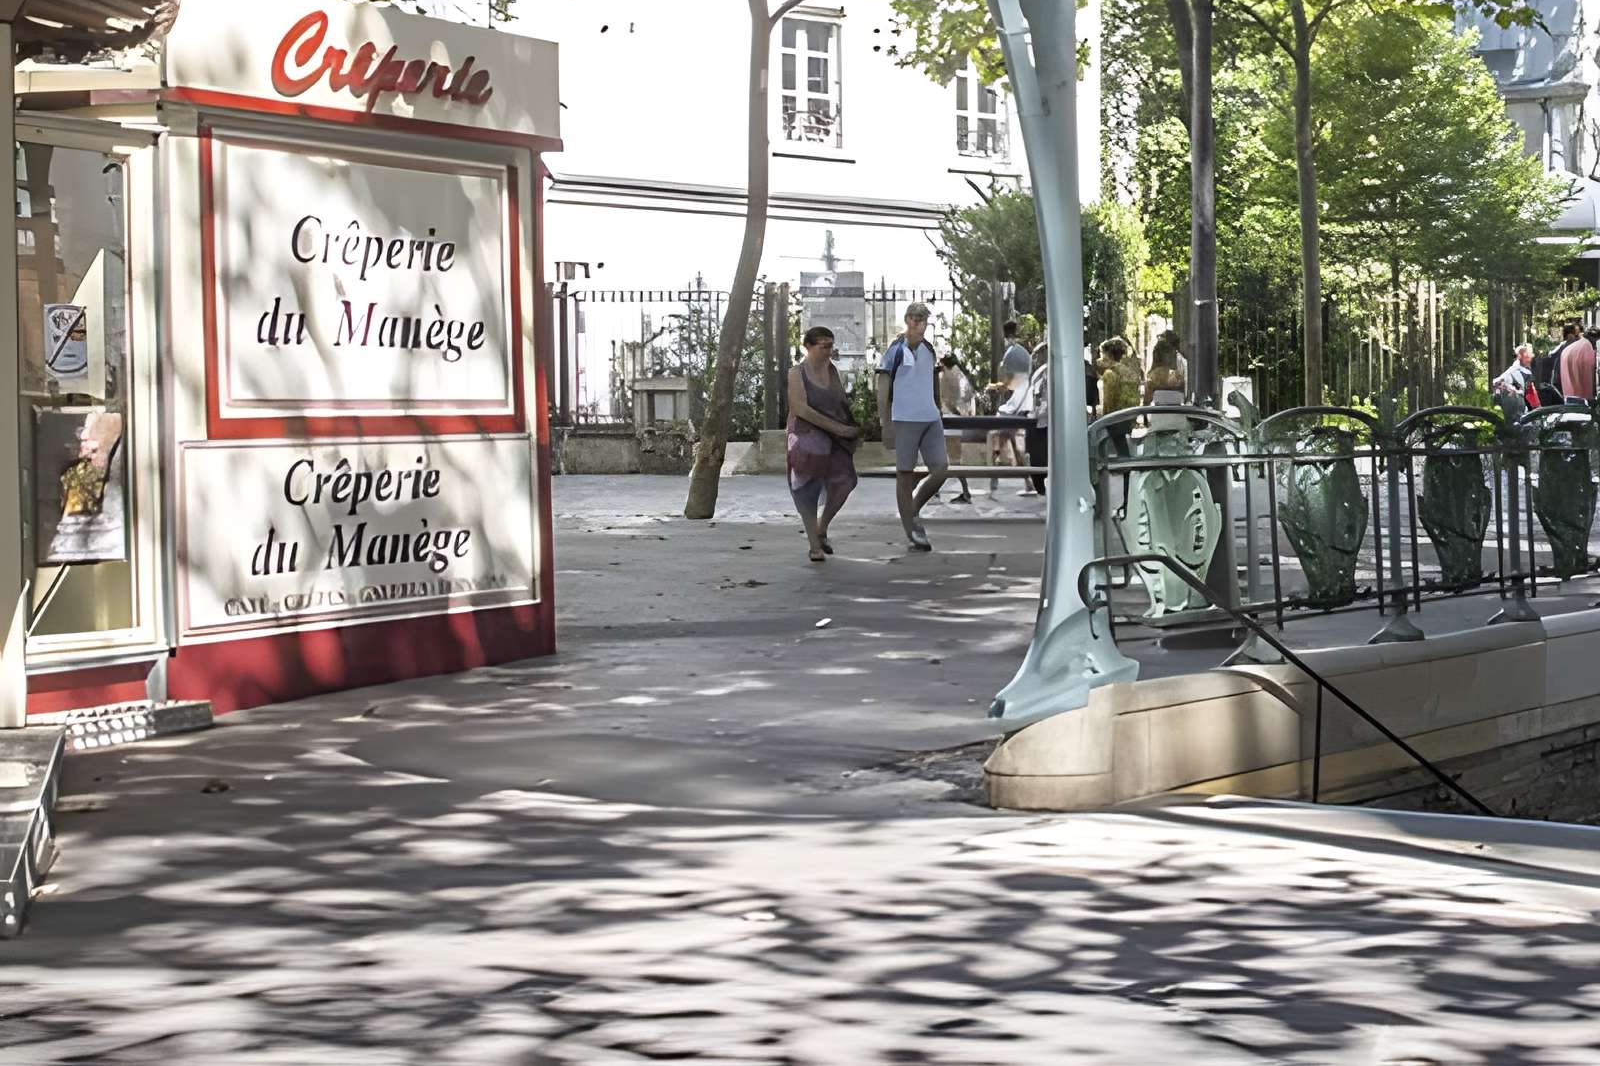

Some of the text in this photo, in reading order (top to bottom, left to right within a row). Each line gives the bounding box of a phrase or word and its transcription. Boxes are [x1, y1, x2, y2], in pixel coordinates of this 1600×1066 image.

[291, 215, 455, 281] Crêperie
[257, 297, 485, 362] du Manège
[284, 456, 440, 515] Crêperie
[251, 518, 471, 575] du Manège
